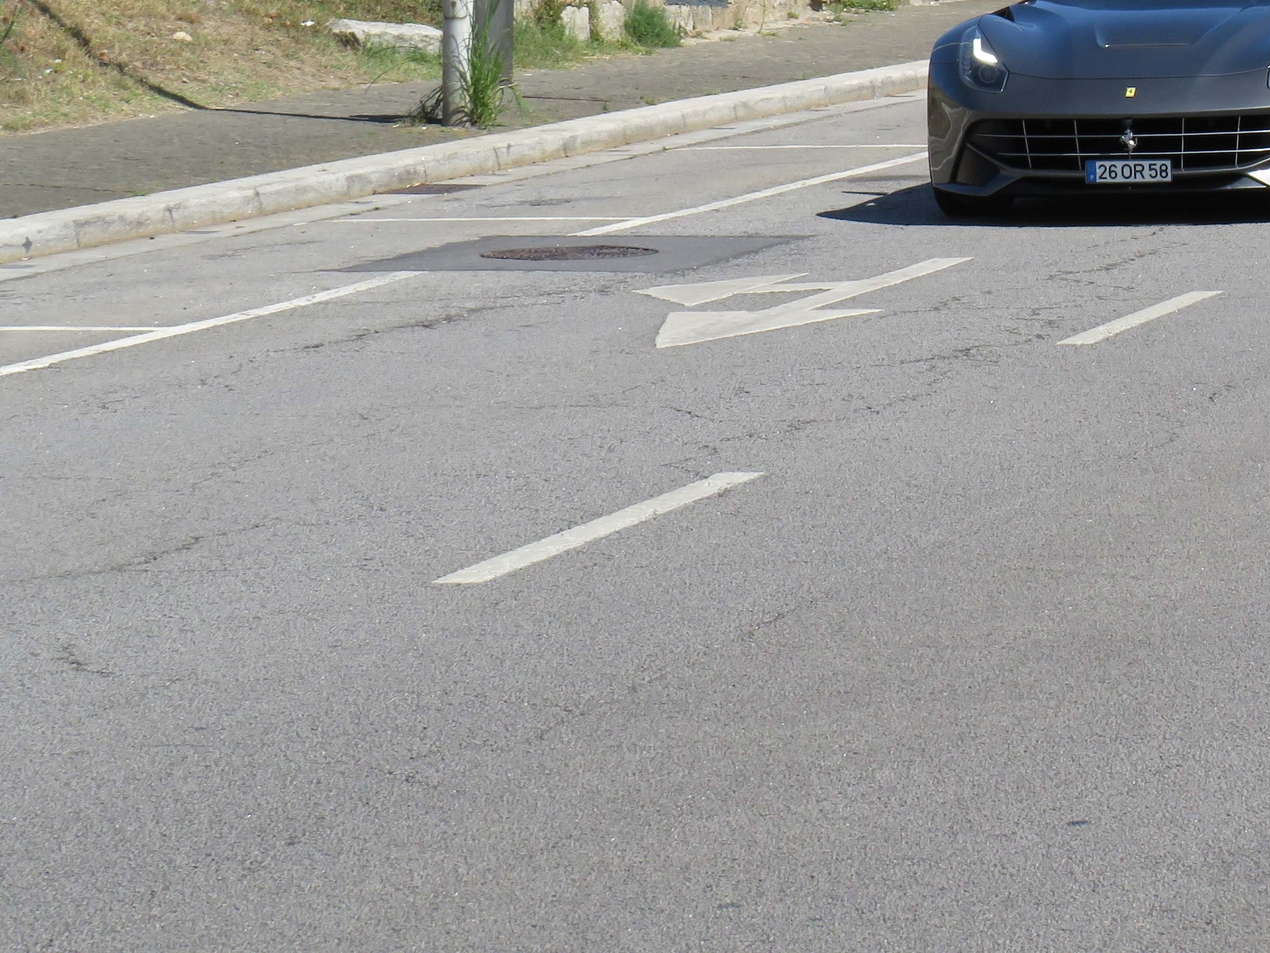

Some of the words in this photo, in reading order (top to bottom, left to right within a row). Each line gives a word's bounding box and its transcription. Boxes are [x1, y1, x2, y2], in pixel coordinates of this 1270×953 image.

[1098, 164, 1118, 180] 26
[1121, 163, 1145, 179] OR
[1148, 163, 1169, 179] 58
